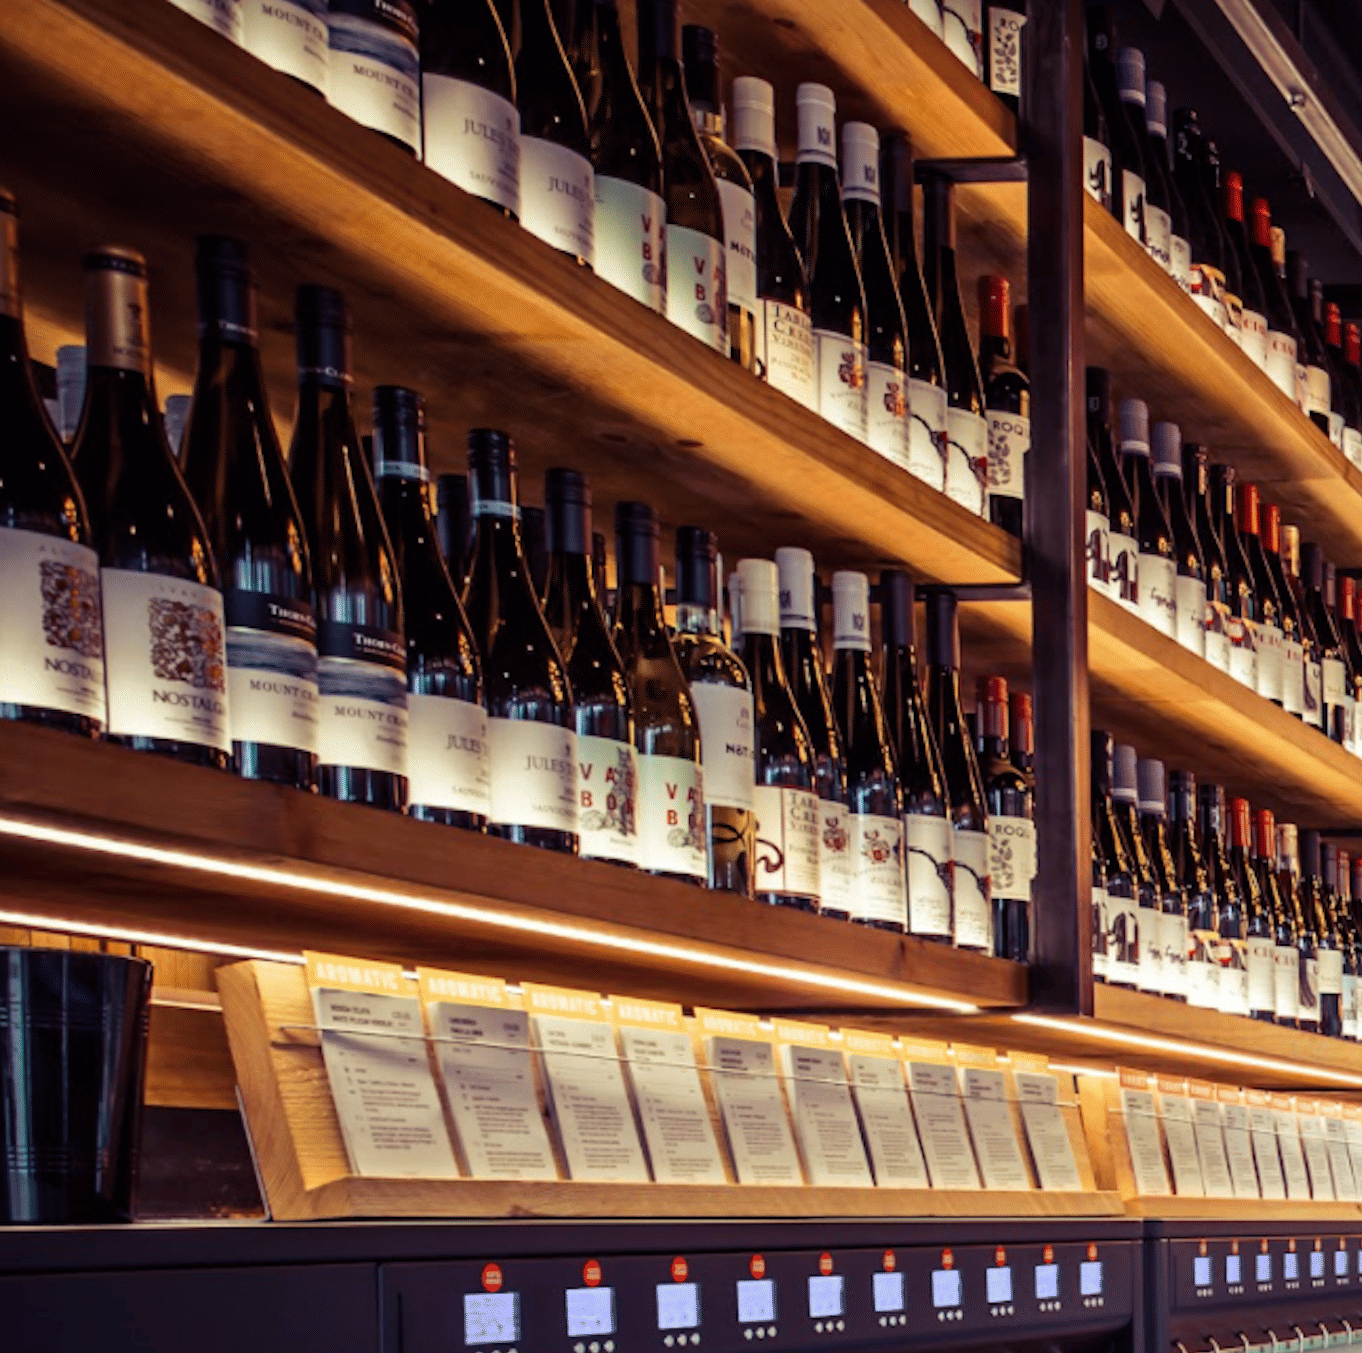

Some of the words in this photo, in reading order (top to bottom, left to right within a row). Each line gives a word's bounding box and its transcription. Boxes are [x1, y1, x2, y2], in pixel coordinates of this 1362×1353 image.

[315, 962, 398, 991] AROMATIC
[428, 977, 505, 1003] AROMATIC
[531, 993, 599, 1017] AROMATIC
